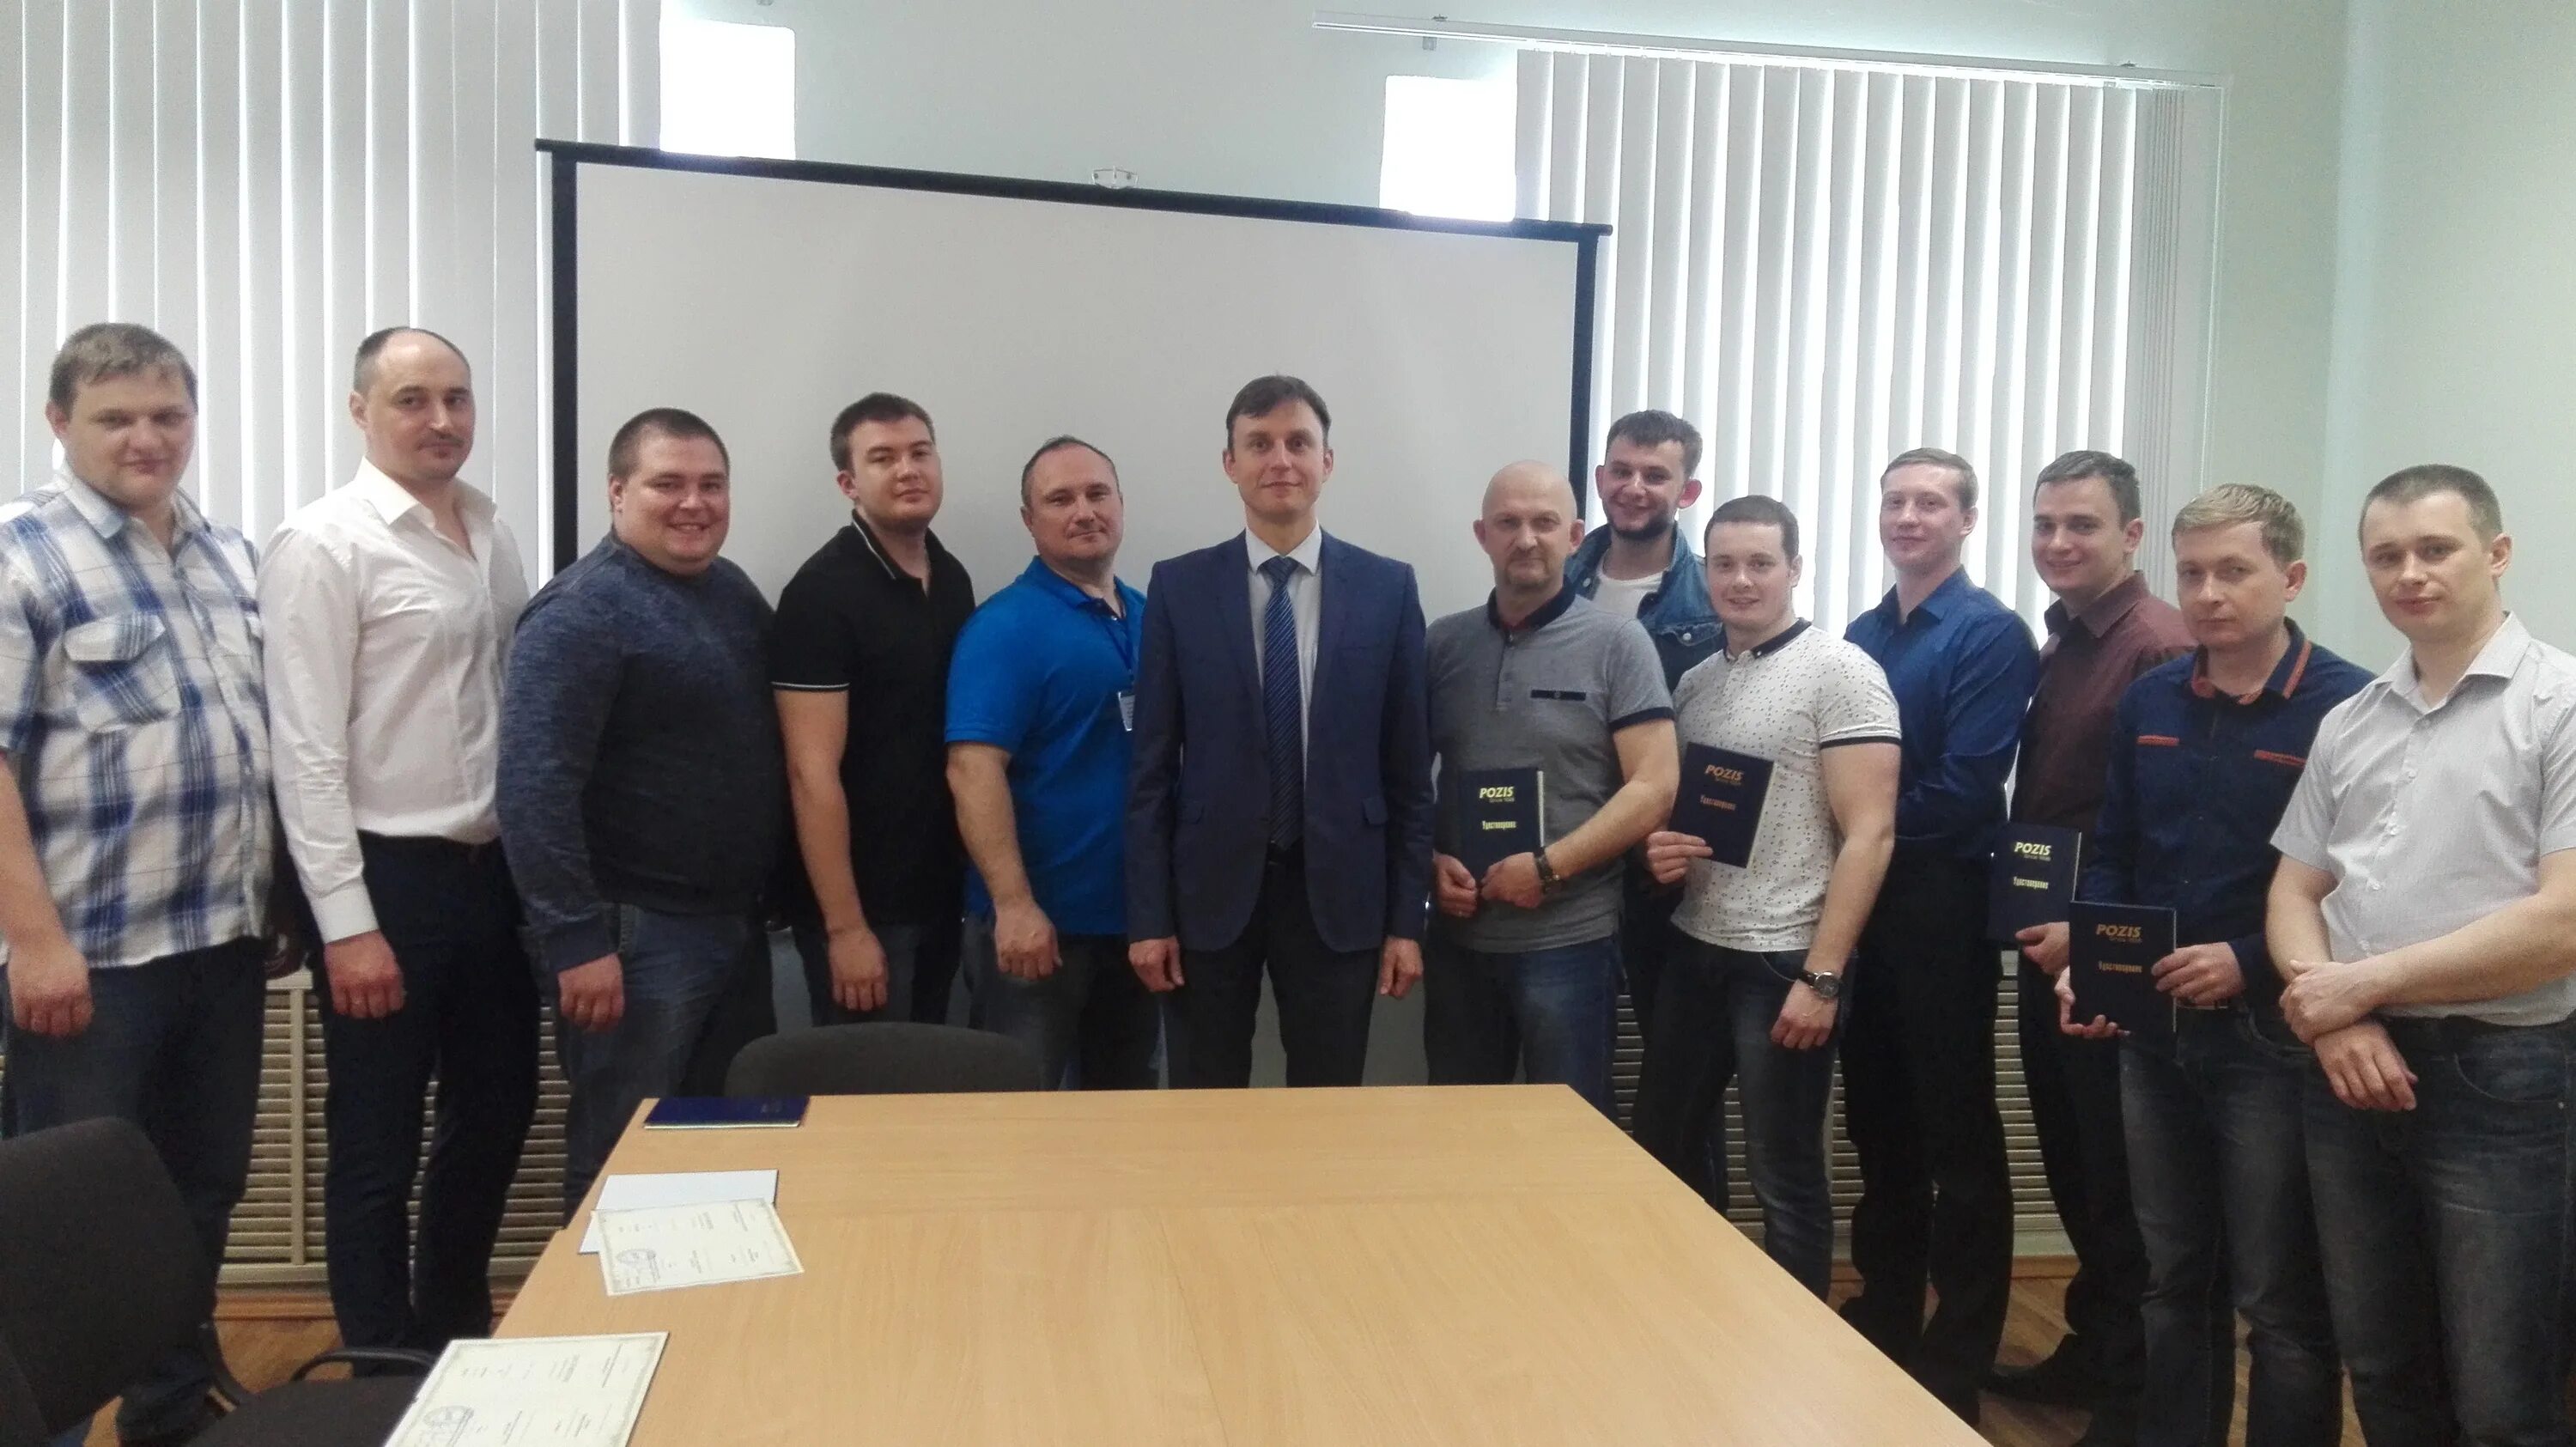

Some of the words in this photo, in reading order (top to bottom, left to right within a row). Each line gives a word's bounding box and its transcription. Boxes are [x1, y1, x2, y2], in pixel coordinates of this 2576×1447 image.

[1704, 763, 1744, 781] POZIS
[1479, 786, 1515, 799] POZIS
[2014, 842, 2052, 855] POZIS
[2096, 923, 2142, 938] POZIS
